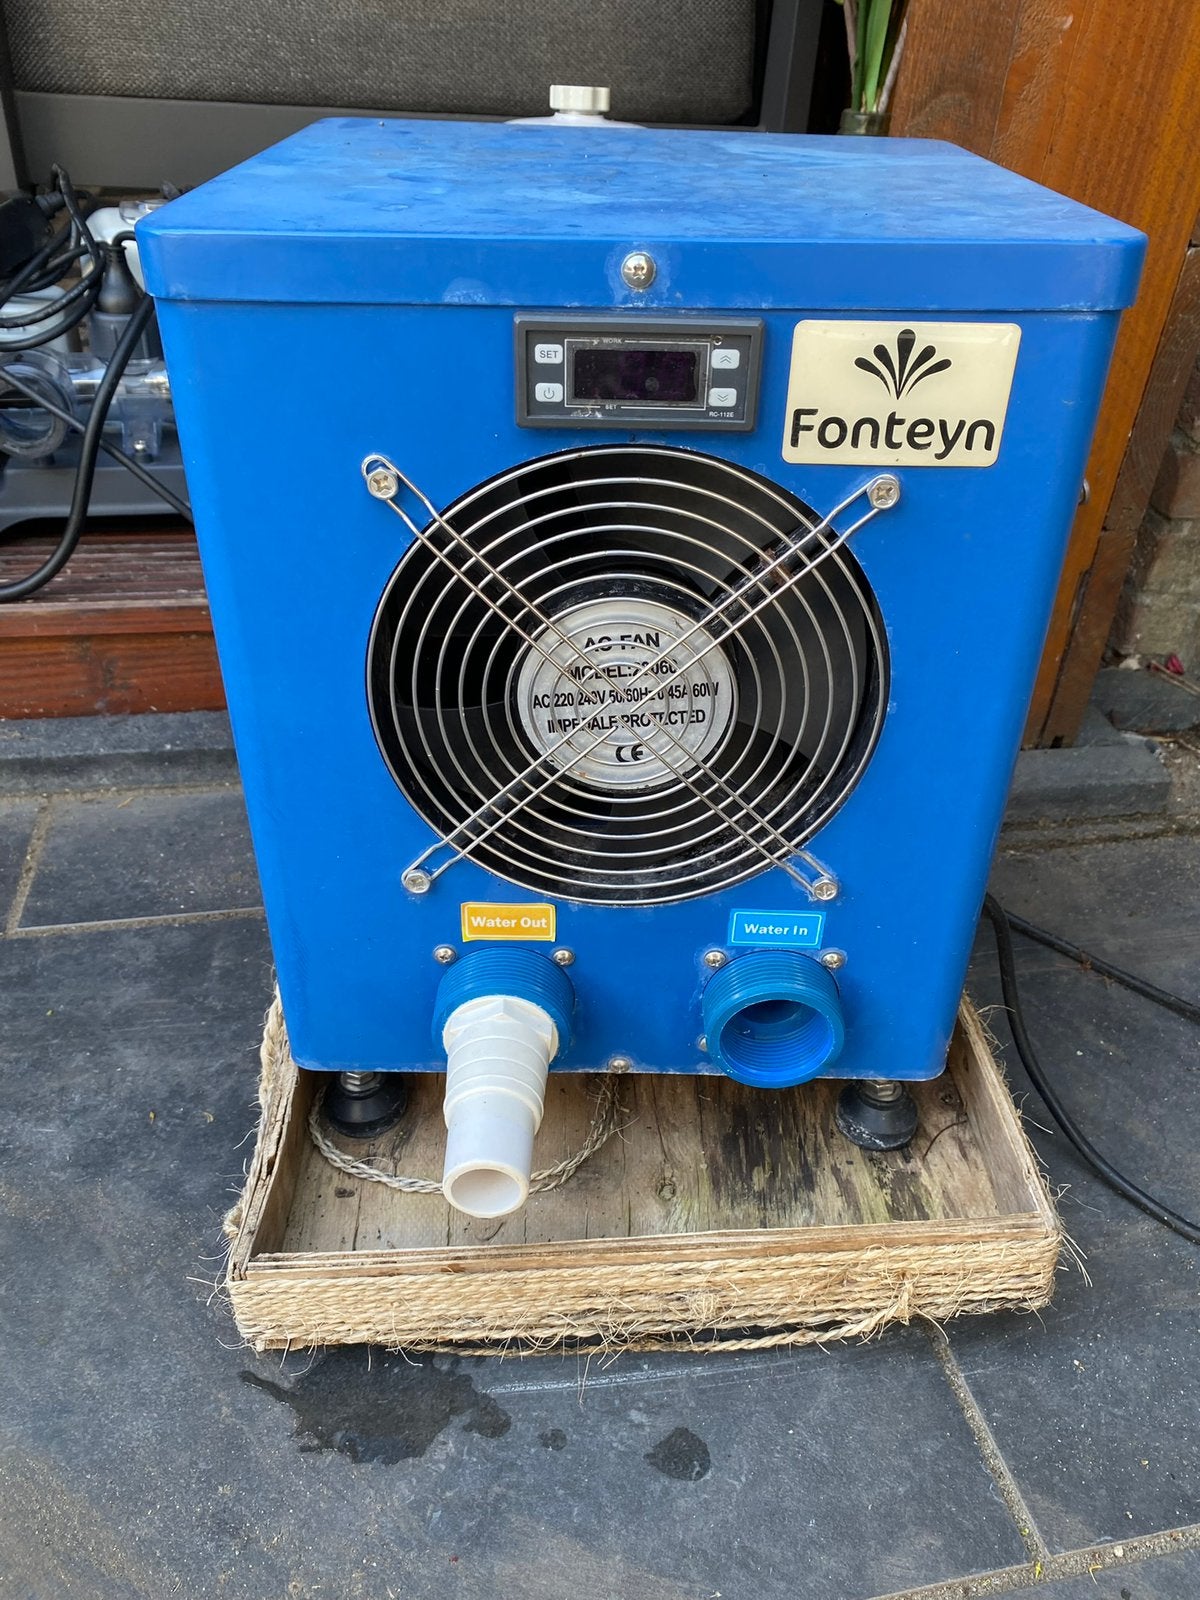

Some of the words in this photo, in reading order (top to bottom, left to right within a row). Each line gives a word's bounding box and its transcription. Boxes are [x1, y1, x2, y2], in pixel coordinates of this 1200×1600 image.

[602, 336, 622, 344] WORK
[539, 349, 559, 359] SET
[790, 408, 995, 460] Fonteyn
[620, 632, 660, 650] FAN
[533, 694, 550, 709] AC
[693, 682, 719, 698] 60W
[471, 916, 517, 929] Water
[520, 916, 548, 929] Out
[744, 923, 788, 935] Water
[793, 924, 808, 936] In
